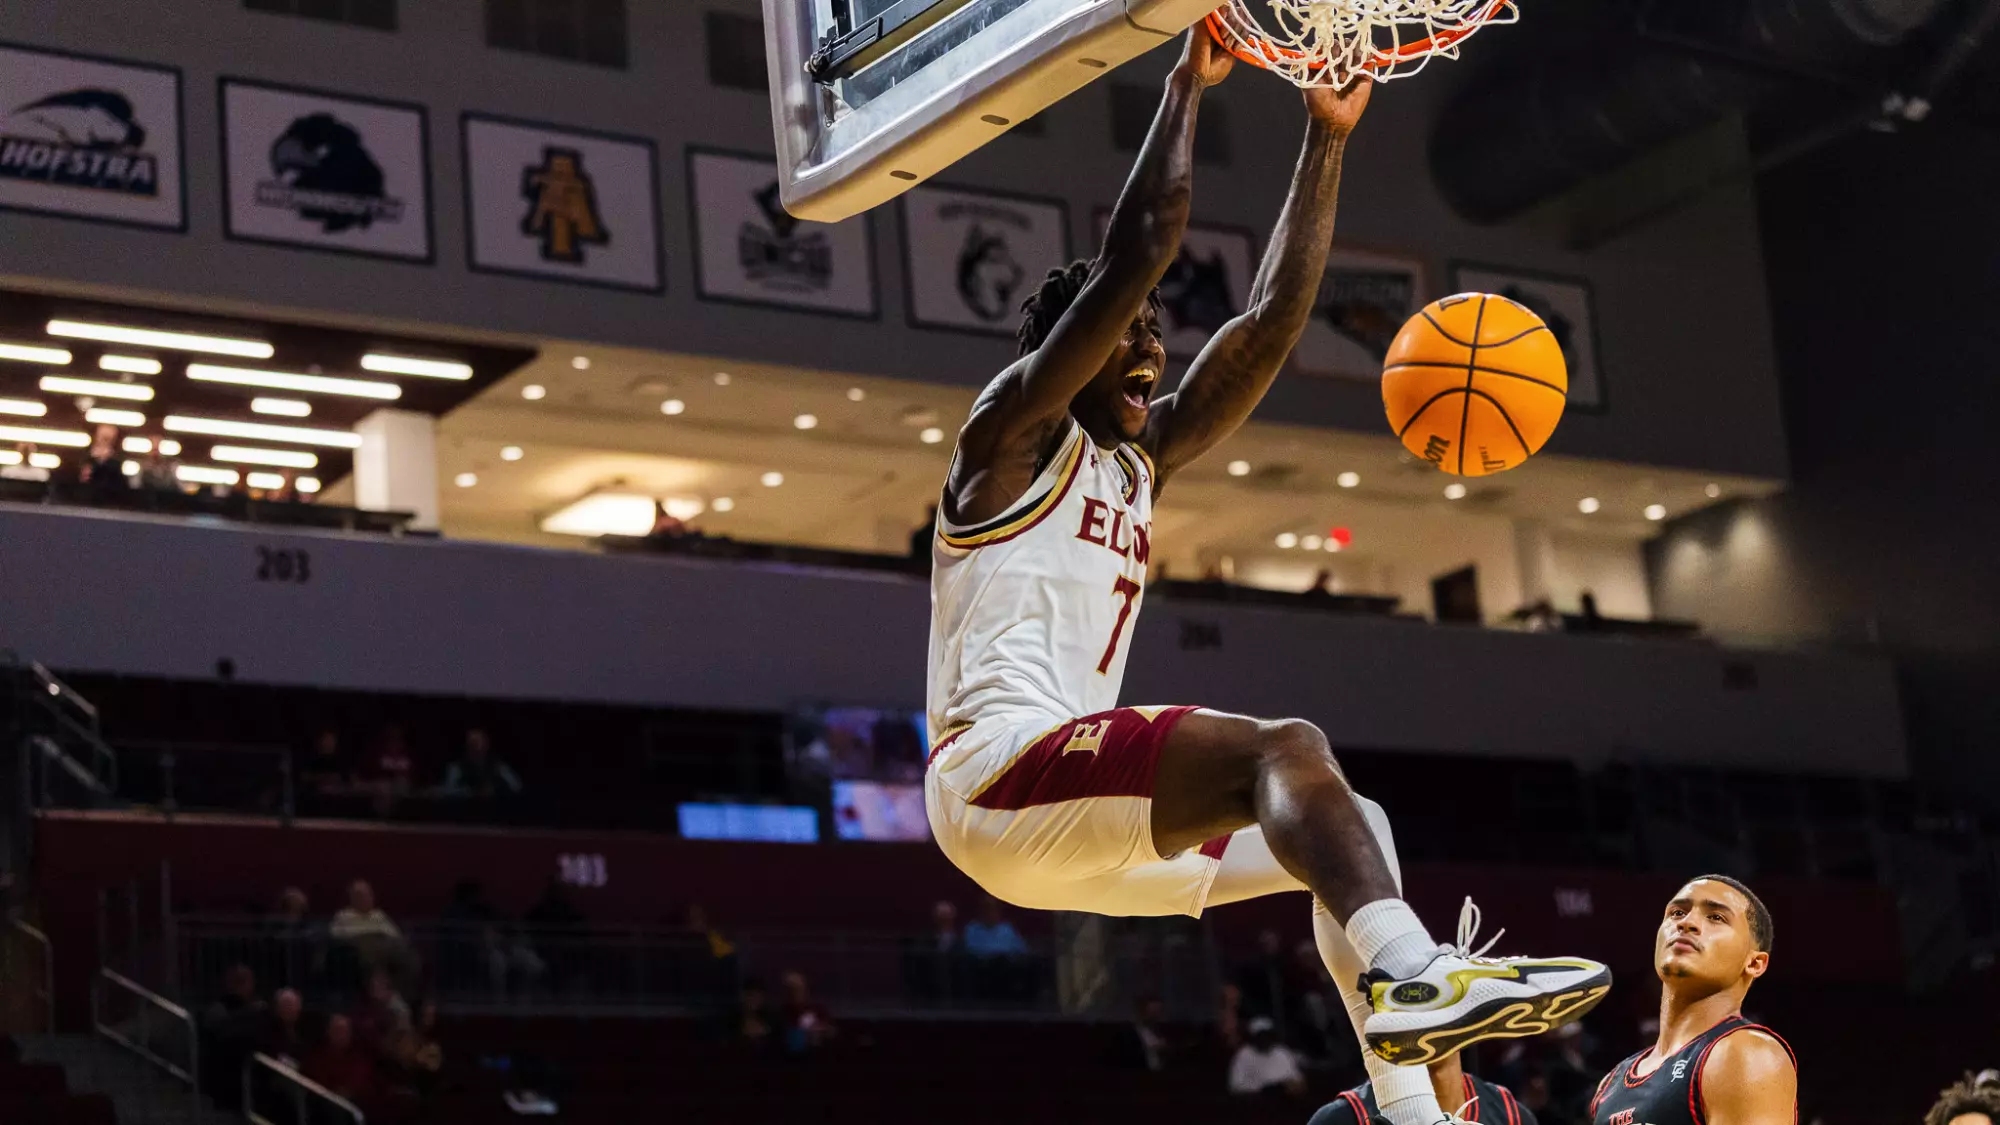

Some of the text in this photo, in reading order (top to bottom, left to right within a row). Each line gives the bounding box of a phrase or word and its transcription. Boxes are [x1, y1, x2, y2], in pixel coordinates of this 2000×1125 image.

[1, 139, 152, 185] HOFSTRA
[255, 545, 310, 585] 203
[1096, 573, 1141, 677] 7
[1062, 719, 1113, 757] E
[1608, 1107, 1637, 1125] THE
